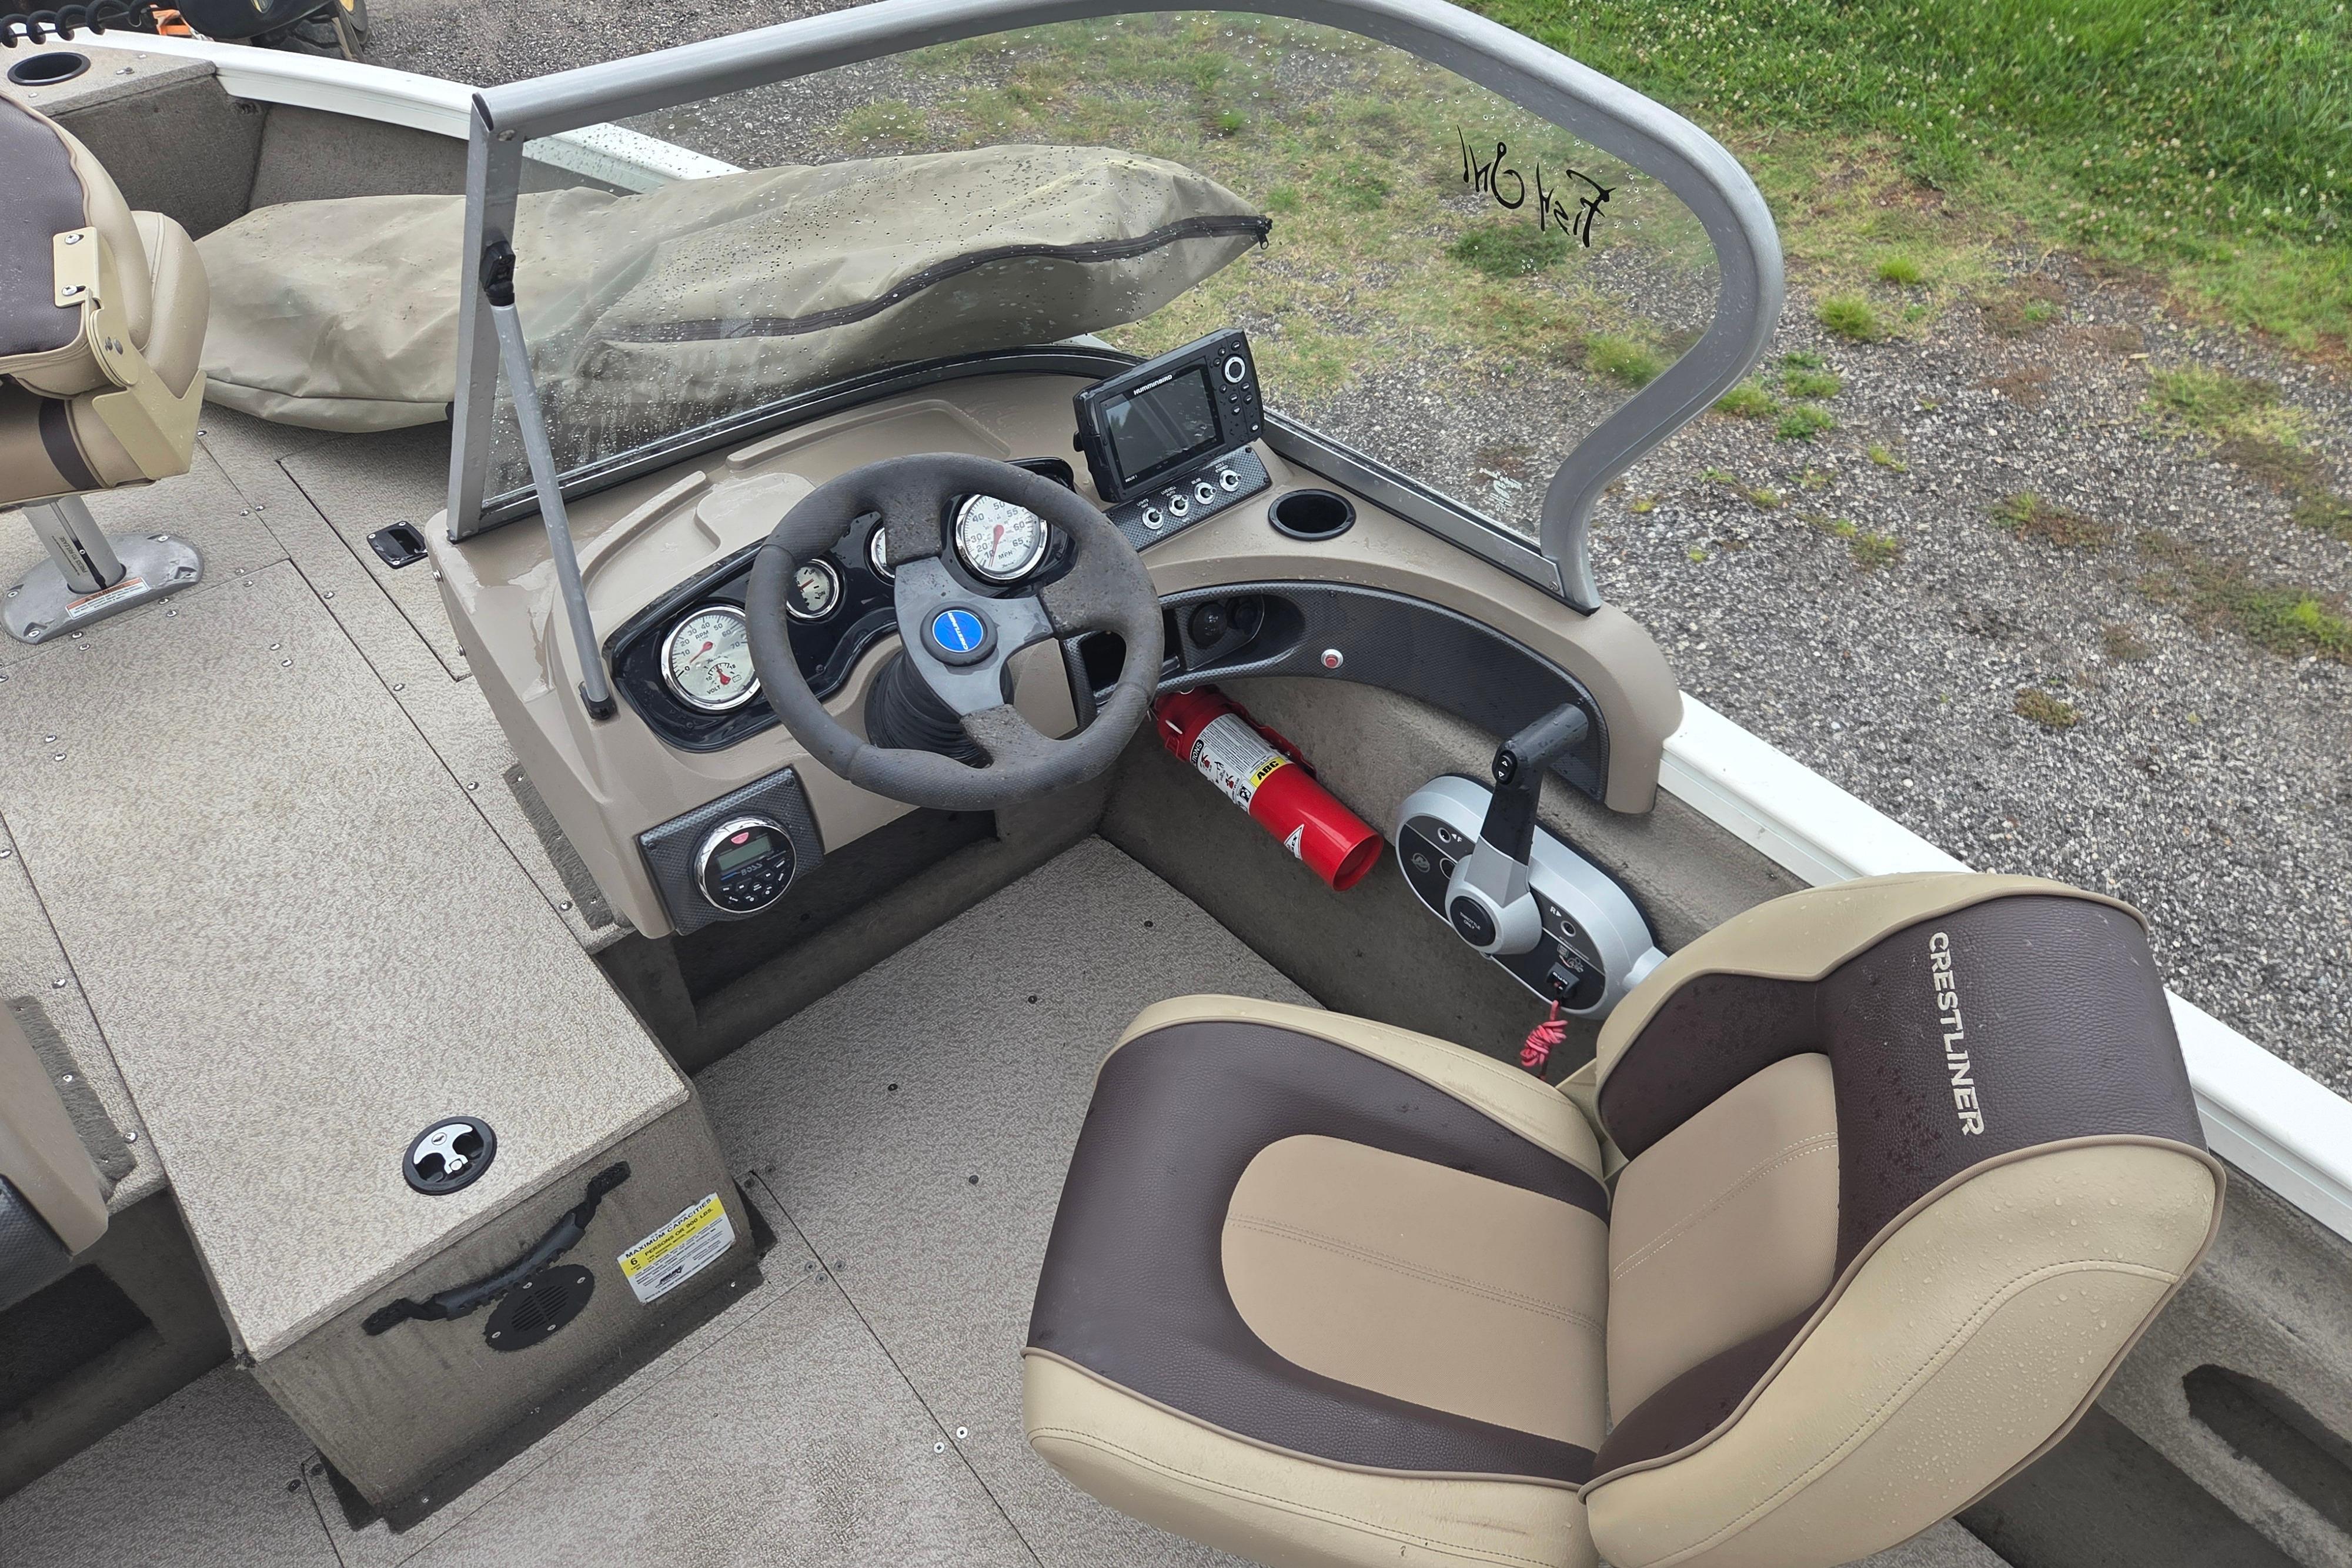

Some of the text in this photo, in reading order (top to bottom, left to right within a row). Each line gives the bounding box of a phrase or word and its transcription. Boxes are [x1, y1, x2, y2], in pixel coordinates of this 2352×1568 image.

[1134, 374, 1172, 396] HUMMINBIRD
[993, 501, 1005, 510] 50
[1006, 507, 1018, 518] 55
[971, 513, 985, 523] 40
[1013, 520, 1025, 531] 60
[970, 533, 983, 543] 30
[1012, 537, 1024, 547] 65
[976, 542, 988, 553] 20
[998, 550, 1013, 560] MPH
[701, 621, 710, 630] 40
[714, 623, 723, 631] 50
[688, 627, 697, 636] 30
[695, 630, 709, 640] RPM
[721, 629, 731, 638] 60
[680, 638, 690, 647] 20
[730, 641, 740, 650] 70
[681, 648, 690, 657] 10
[707, 684, 721, 696] VOLT
[1256, 760, 1279, 781] ABC
[1550, 906, 1556, 915] R
[1929, 932, 1984, 1136] CRESTLINER
[625, 1232, 666, 1259] MAXIMUM
[667, 1198, 711, 1232] CAPACITIES
[644, 1235, 674, 1256] PERSONS
[675, 1228, 684, 1236] OR
[686, 1218, 698, 1228] 900
